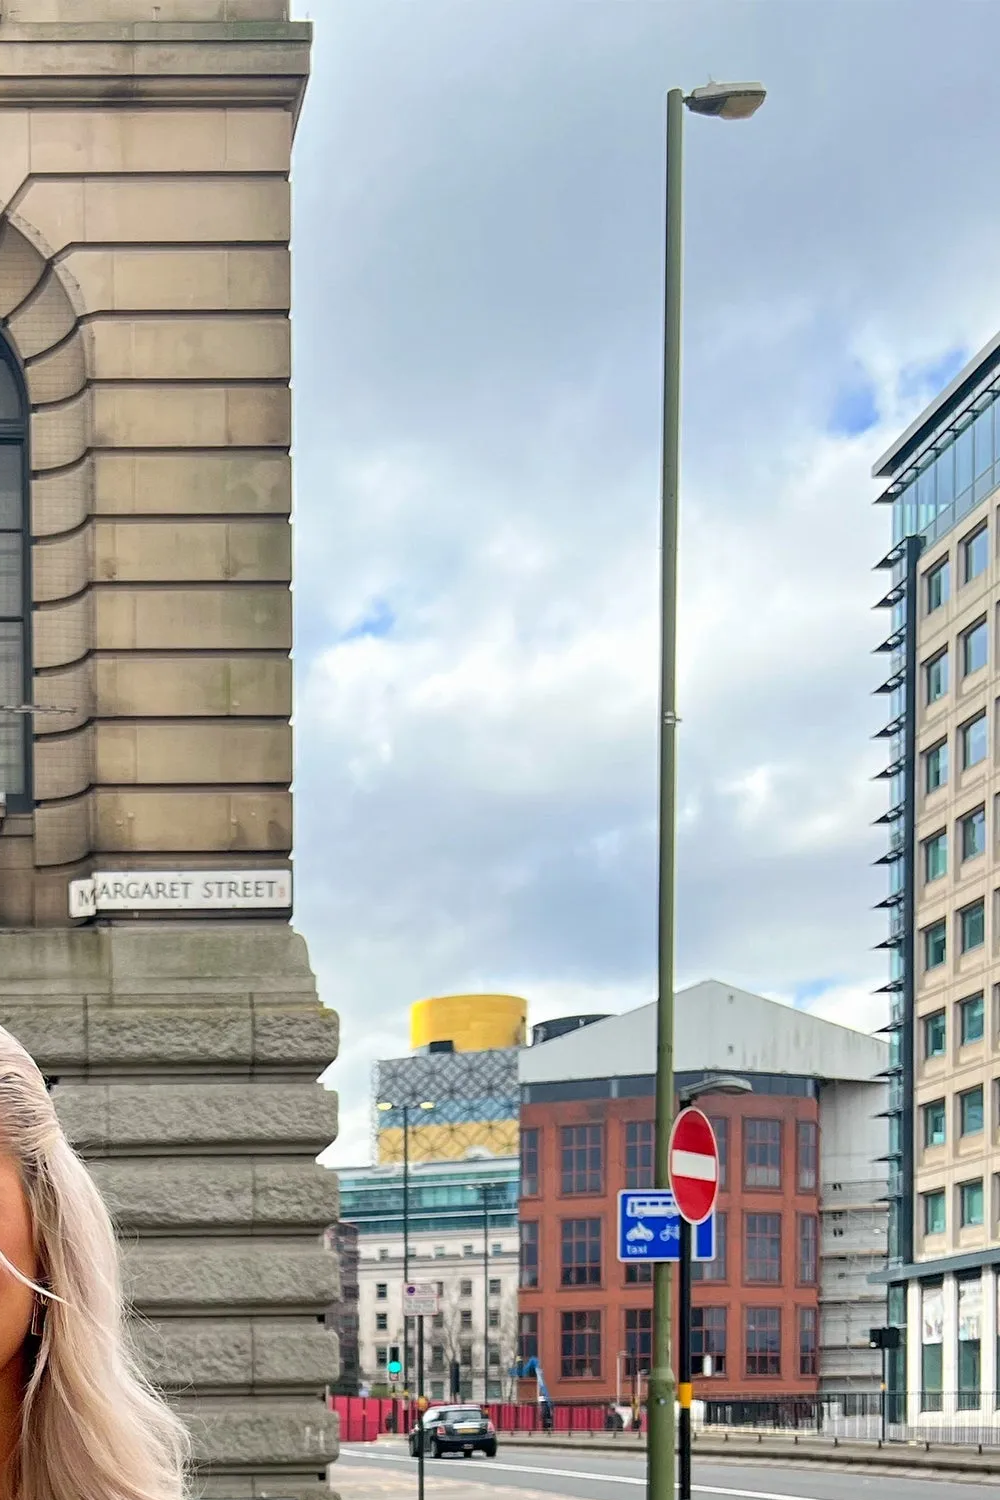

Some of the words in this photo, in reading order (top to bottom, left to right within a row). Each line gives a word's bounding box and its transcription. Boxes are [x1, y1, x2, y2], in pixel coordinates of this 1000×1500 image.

[78, 882, 192, 906] MARGARET
[203, 881, 277, 898] STREET
[627, 1245, 647, 1254] taxi
